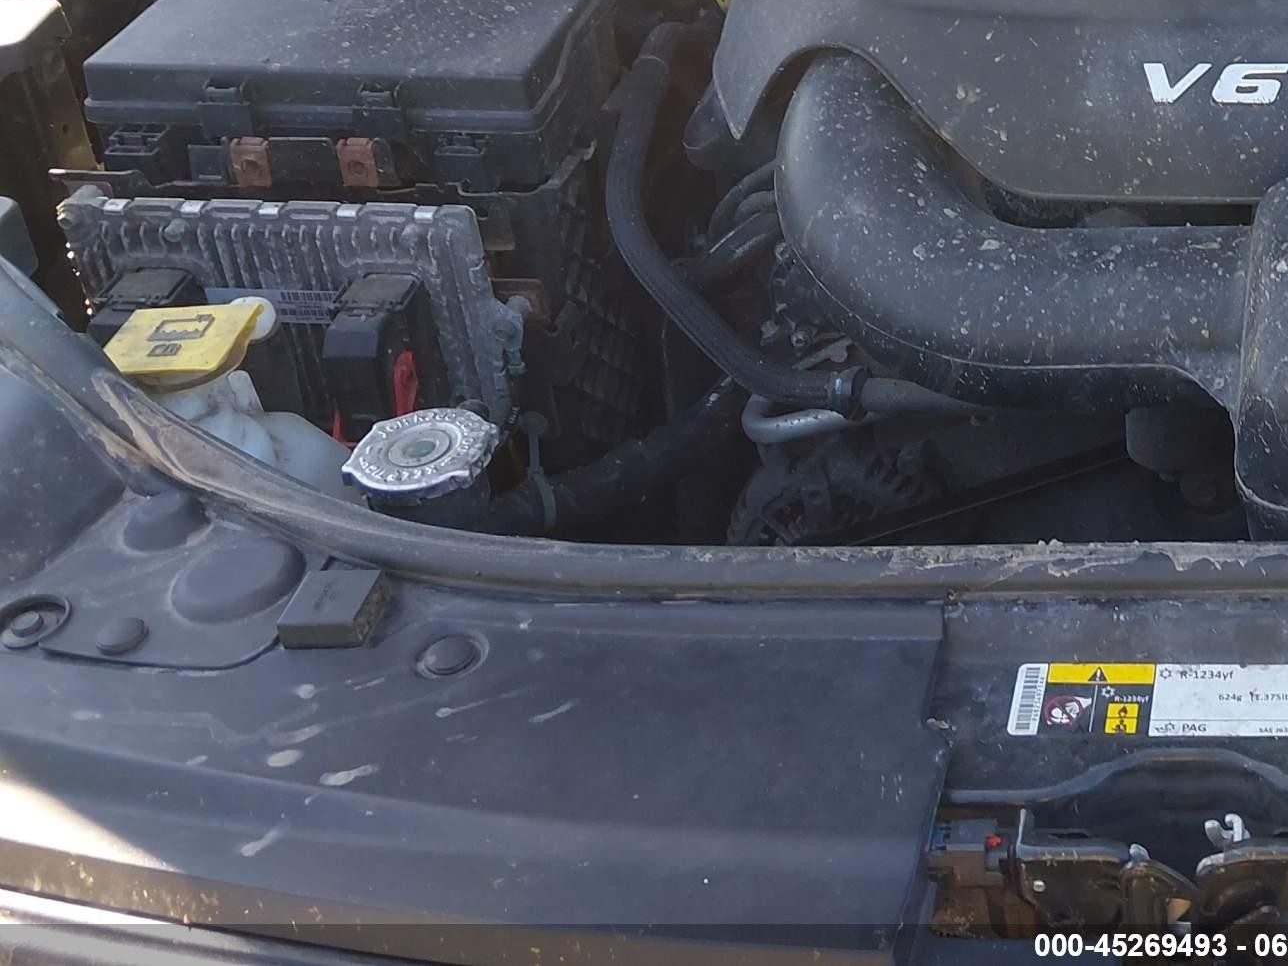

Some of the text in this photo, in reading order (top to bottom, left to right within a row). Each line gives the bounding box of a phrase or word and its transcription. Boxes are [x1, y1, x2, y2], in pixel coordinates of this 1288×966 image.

[1178, 670, 1234, 681] R-1234yf
[1218, 693, 1242, 702] 624g
[1181, 723, 1207, 732] PAG
